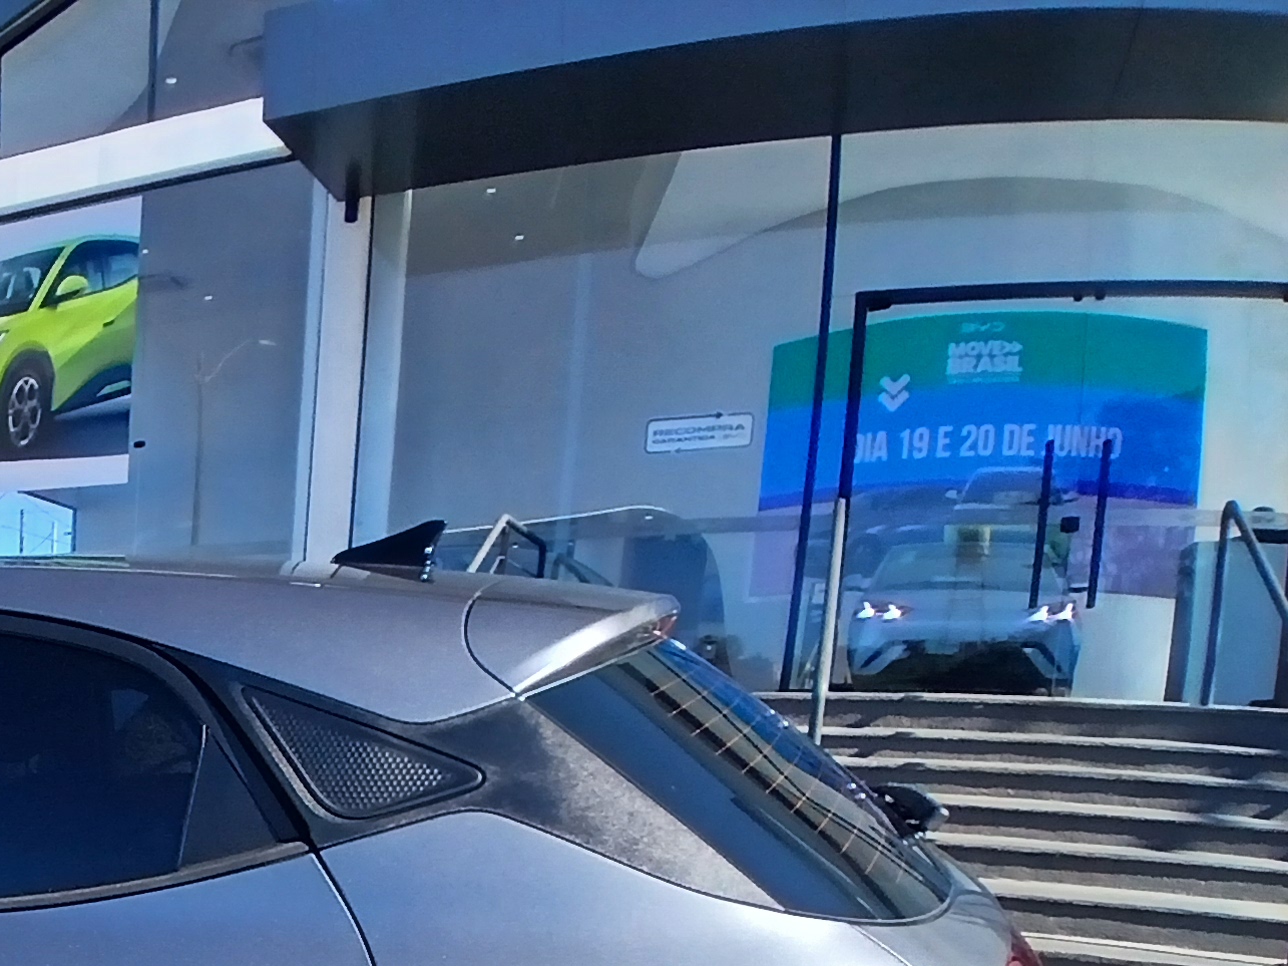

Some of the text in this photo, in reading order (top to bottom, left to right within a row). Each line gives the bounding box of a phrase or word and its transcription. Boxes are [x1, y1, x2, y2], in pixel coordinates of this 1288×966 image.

[900, 426, 931, 460] 19
[936, 425, 953, 458] E
[959, 423, 996, 457] 20
[1002, 423, 1037, 457] DE
